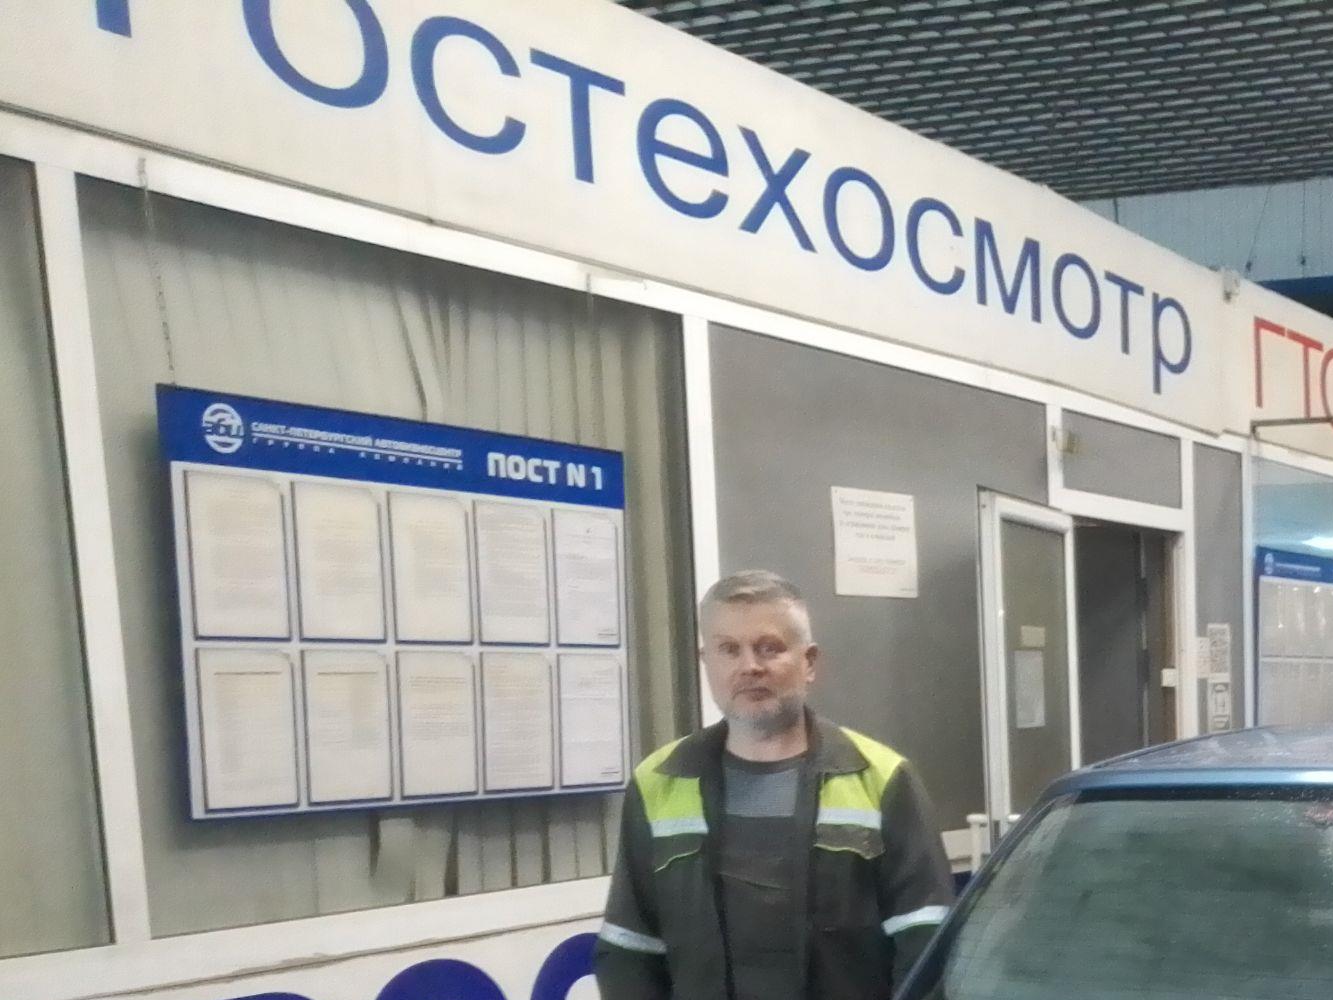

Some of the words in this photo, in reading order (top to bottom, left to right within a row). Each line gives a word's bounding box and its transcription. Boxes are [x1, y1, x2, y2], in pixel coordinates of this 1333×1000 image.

[96, 0, 1192, 393] остехосмотр
[487, 451, 560, 485] ПОСТ
[591, 465, 603, 491] 1
